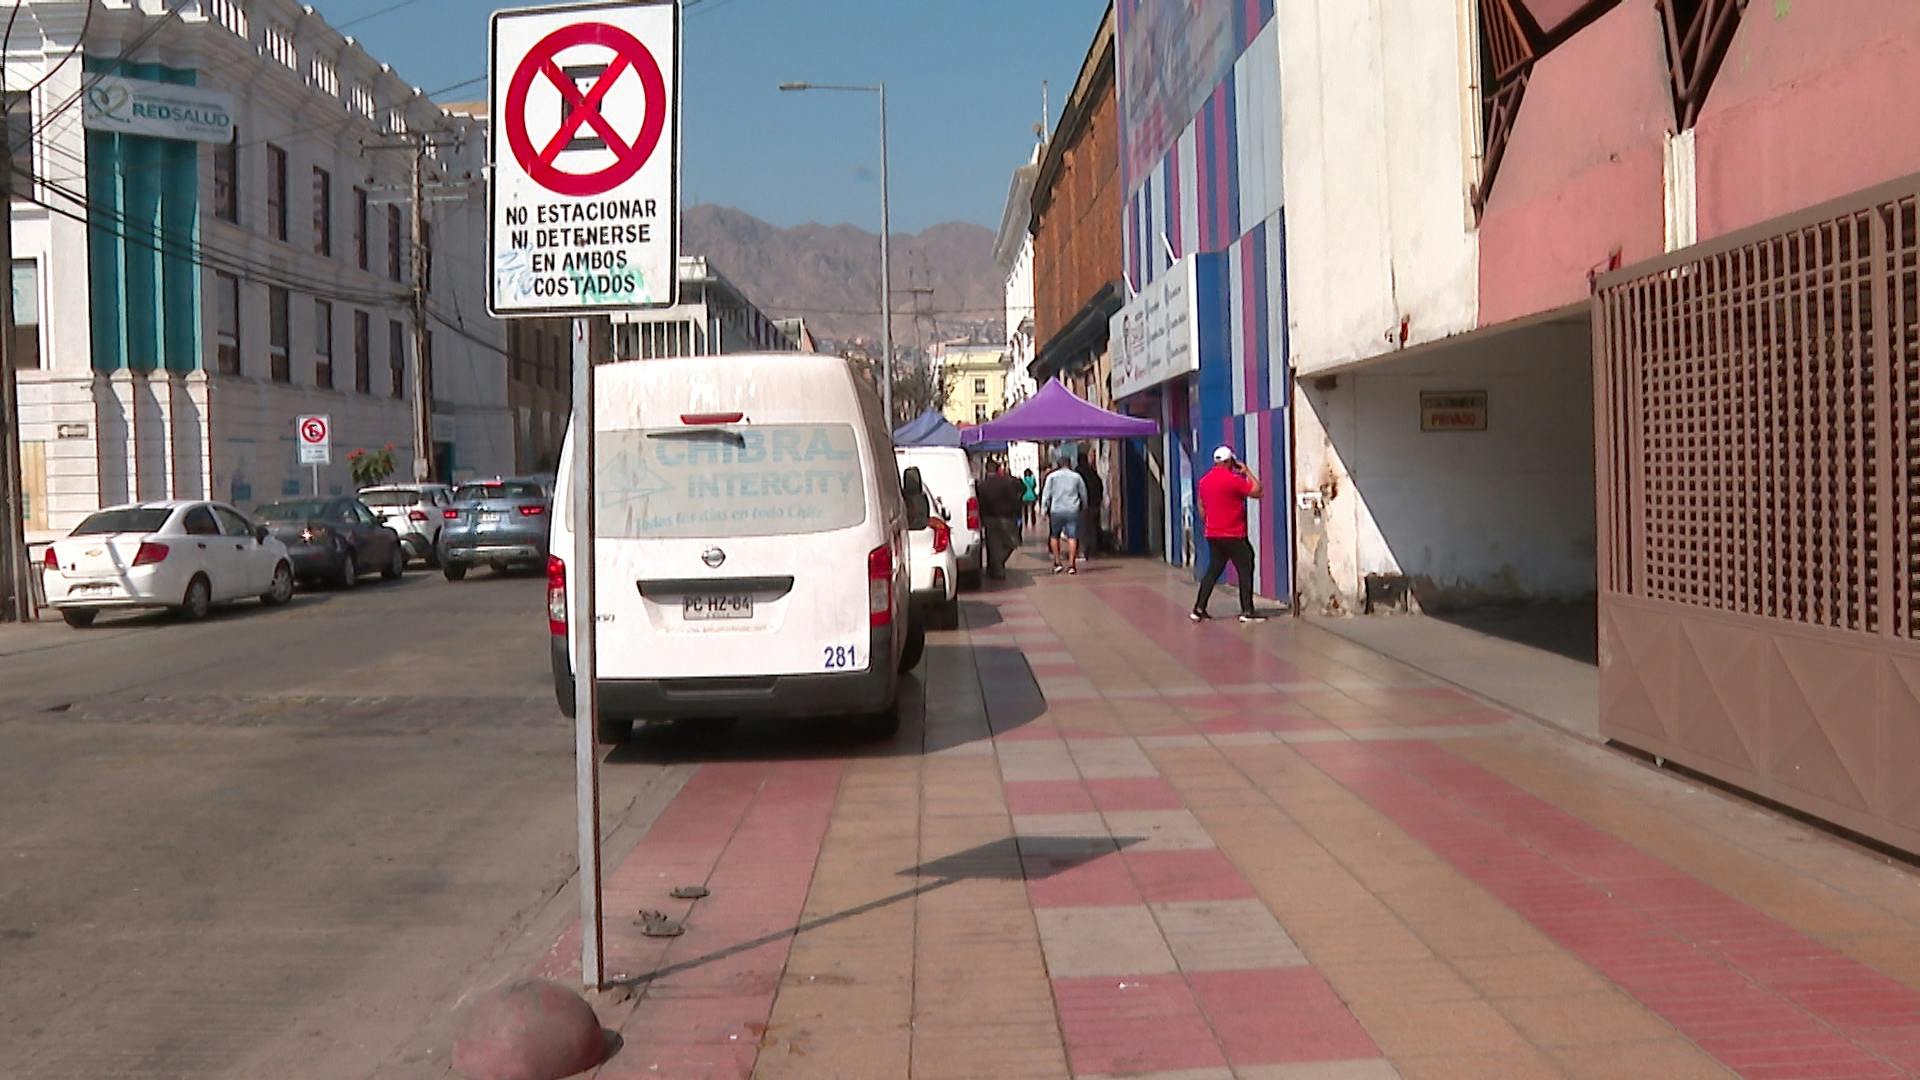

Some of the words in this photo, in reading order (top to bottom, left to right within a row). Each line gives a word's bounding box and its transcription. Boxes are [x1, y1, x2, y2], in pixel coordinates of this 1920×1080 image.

[132, 102, 230, 127] REDSALUD
[506, 206, 528, 225] NO
[537, 199, 656, 223] ESTACIONAR
[511, 230, 529, 249] NI
[536, 224, 651, 248] DETENERSE
[532, 253, 555, 272] EN
[562, 250, 628, 271] AMBOS
[534, 275, 636, 296] COSTADOS
[656, 428, 838, 466] CHIBRA
[688, 470, 854, 498] INTERCITY
[823, 645, 857, 669] 281
